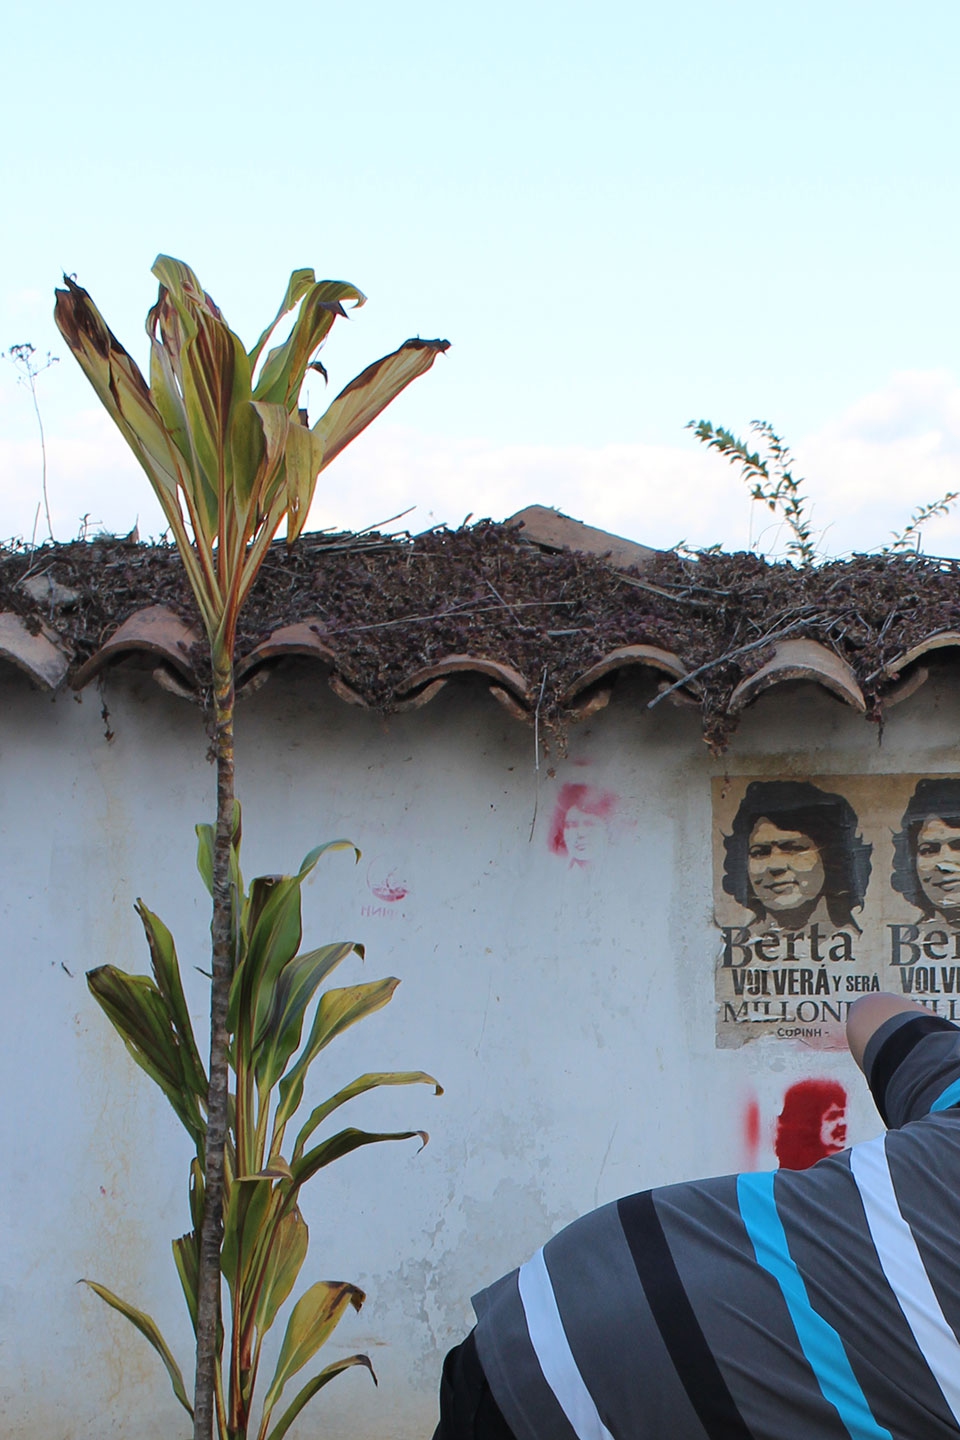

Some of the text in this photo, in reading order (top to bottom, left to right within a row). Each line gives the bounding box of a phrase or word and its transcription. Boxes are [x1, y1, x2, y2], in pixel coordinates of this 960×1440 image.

[721, 922, 856, 969] Berta
[732, 964, 881, 996] VOLVERÁ Y SERÁ
[723, 1000, 851, 1024] MILLON
[777, 1027, 822, 1038] COPINH
